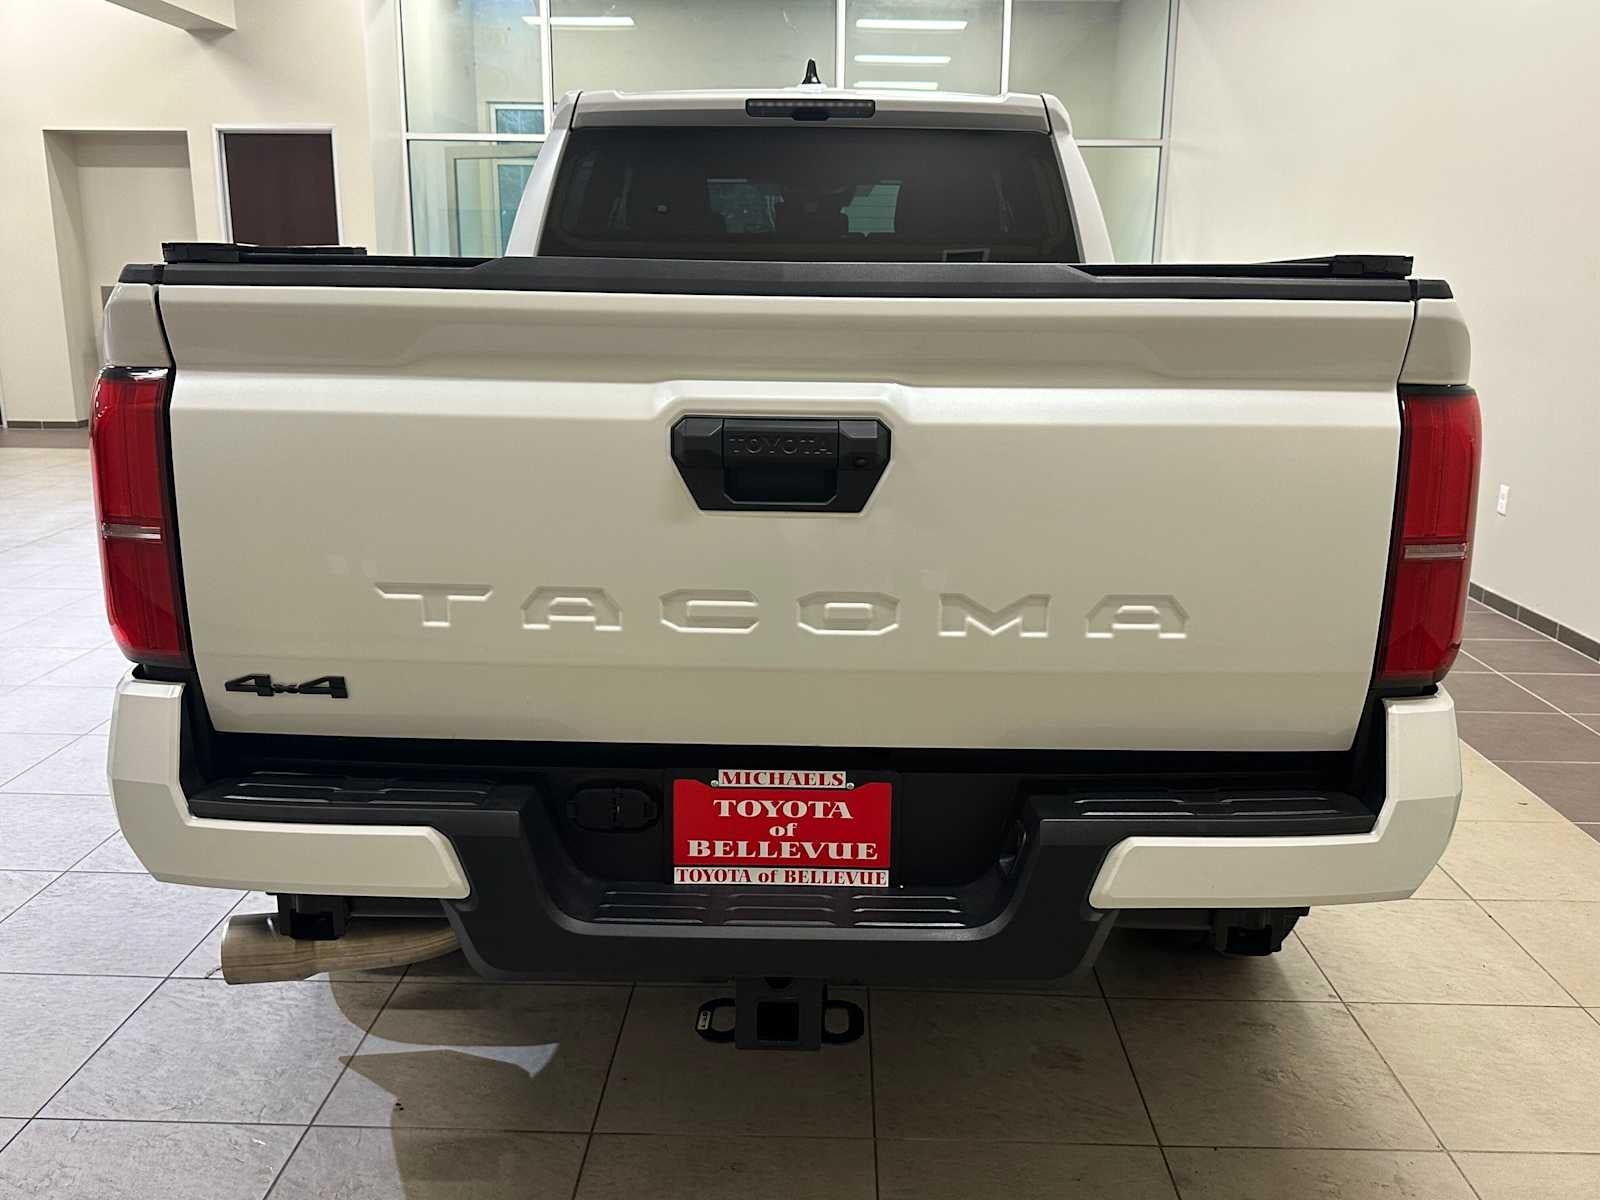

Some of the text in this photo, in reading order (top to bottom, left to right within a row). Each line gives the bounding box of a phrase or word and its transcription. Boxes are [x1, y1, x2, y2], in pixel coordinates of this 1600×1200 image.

[728, 435, 833, 455] TOYOTA
[374, 582, 1190, 639] TACOMA
[721, 771, 845, 786] MICHAELS
[713, 799, 854, 819] TOYOTA
[769, 823, 797, 837] of
[687, 839, 878, 860] BELLEVUE
[676, 868, 887, 886] TOYOTA of BELLEVUE
